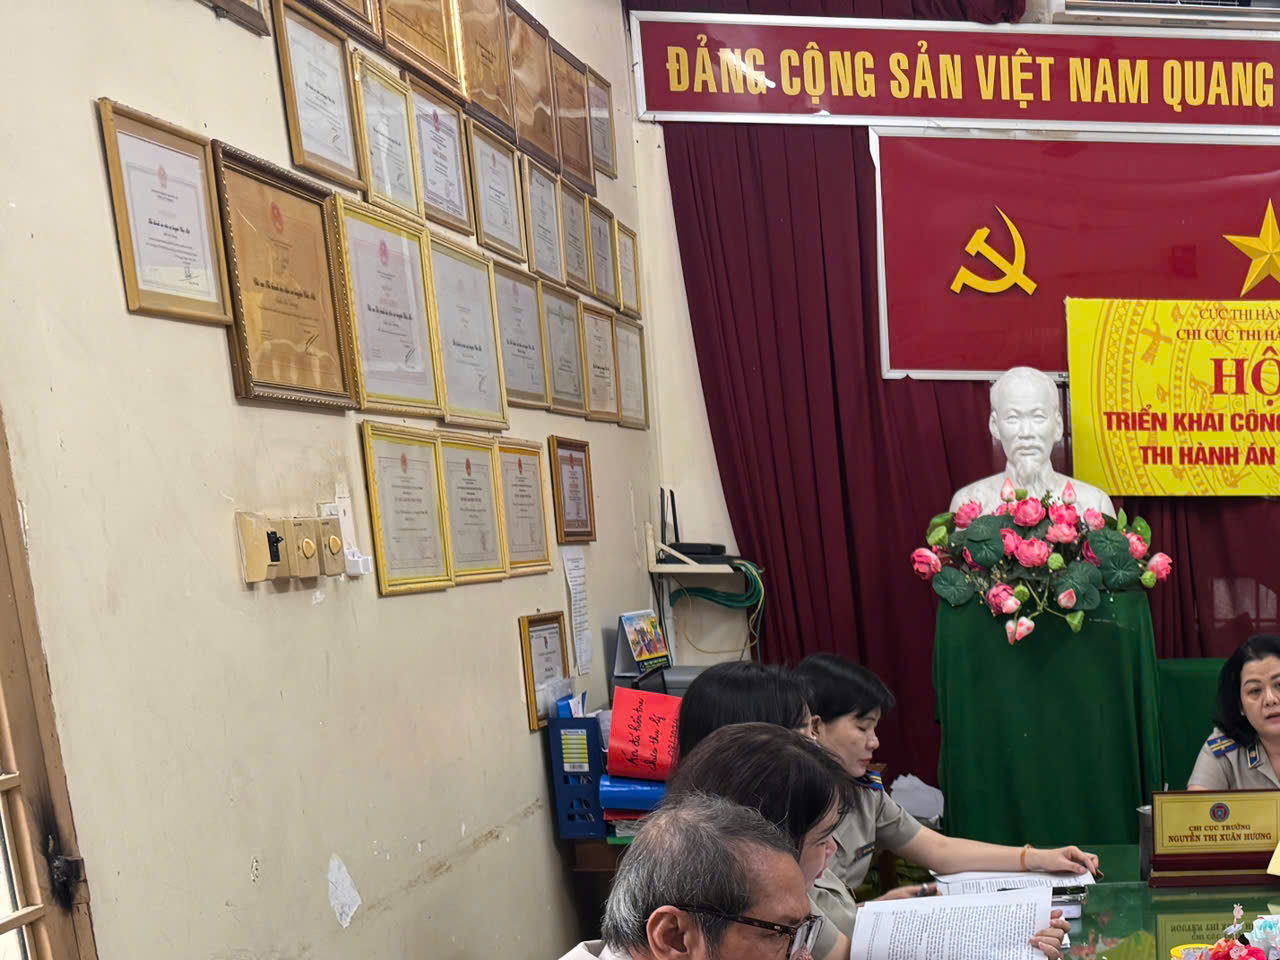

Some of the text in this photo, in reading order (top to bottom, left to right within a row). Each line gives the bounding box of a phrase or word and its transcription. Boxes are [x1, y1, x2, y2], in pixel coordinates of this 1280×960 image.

[666, 34, 767, 95] ĐẢNG
[780, 41, 876, 104] CỘNG
[889, 40, 961, 100] SẢN
[975, 47, 1054, 109] VIỆT
[1069, 57, 1149, 104] NAM
[1162, 60, 1274, 112] QUANG
[1199, 308, 1230, 322] CỤC
[1232, 309, 1253, 321] THI
[1176, 328, 1201, 341] CHI
[1204, 328, 1234, 343] CỤC
[1237, 329, 1262, 341] THI
[1104, 404, 1168, 432] TRIỂN
[1173, 413, 1224, 432] KHAI
[1139, 446, 1173, 465] THI
[1179, 442, 1238, 465] HÀNH
[1245, 442, 1276, 465] ÁN
[1204, 824, 1219, 832] CỤC
